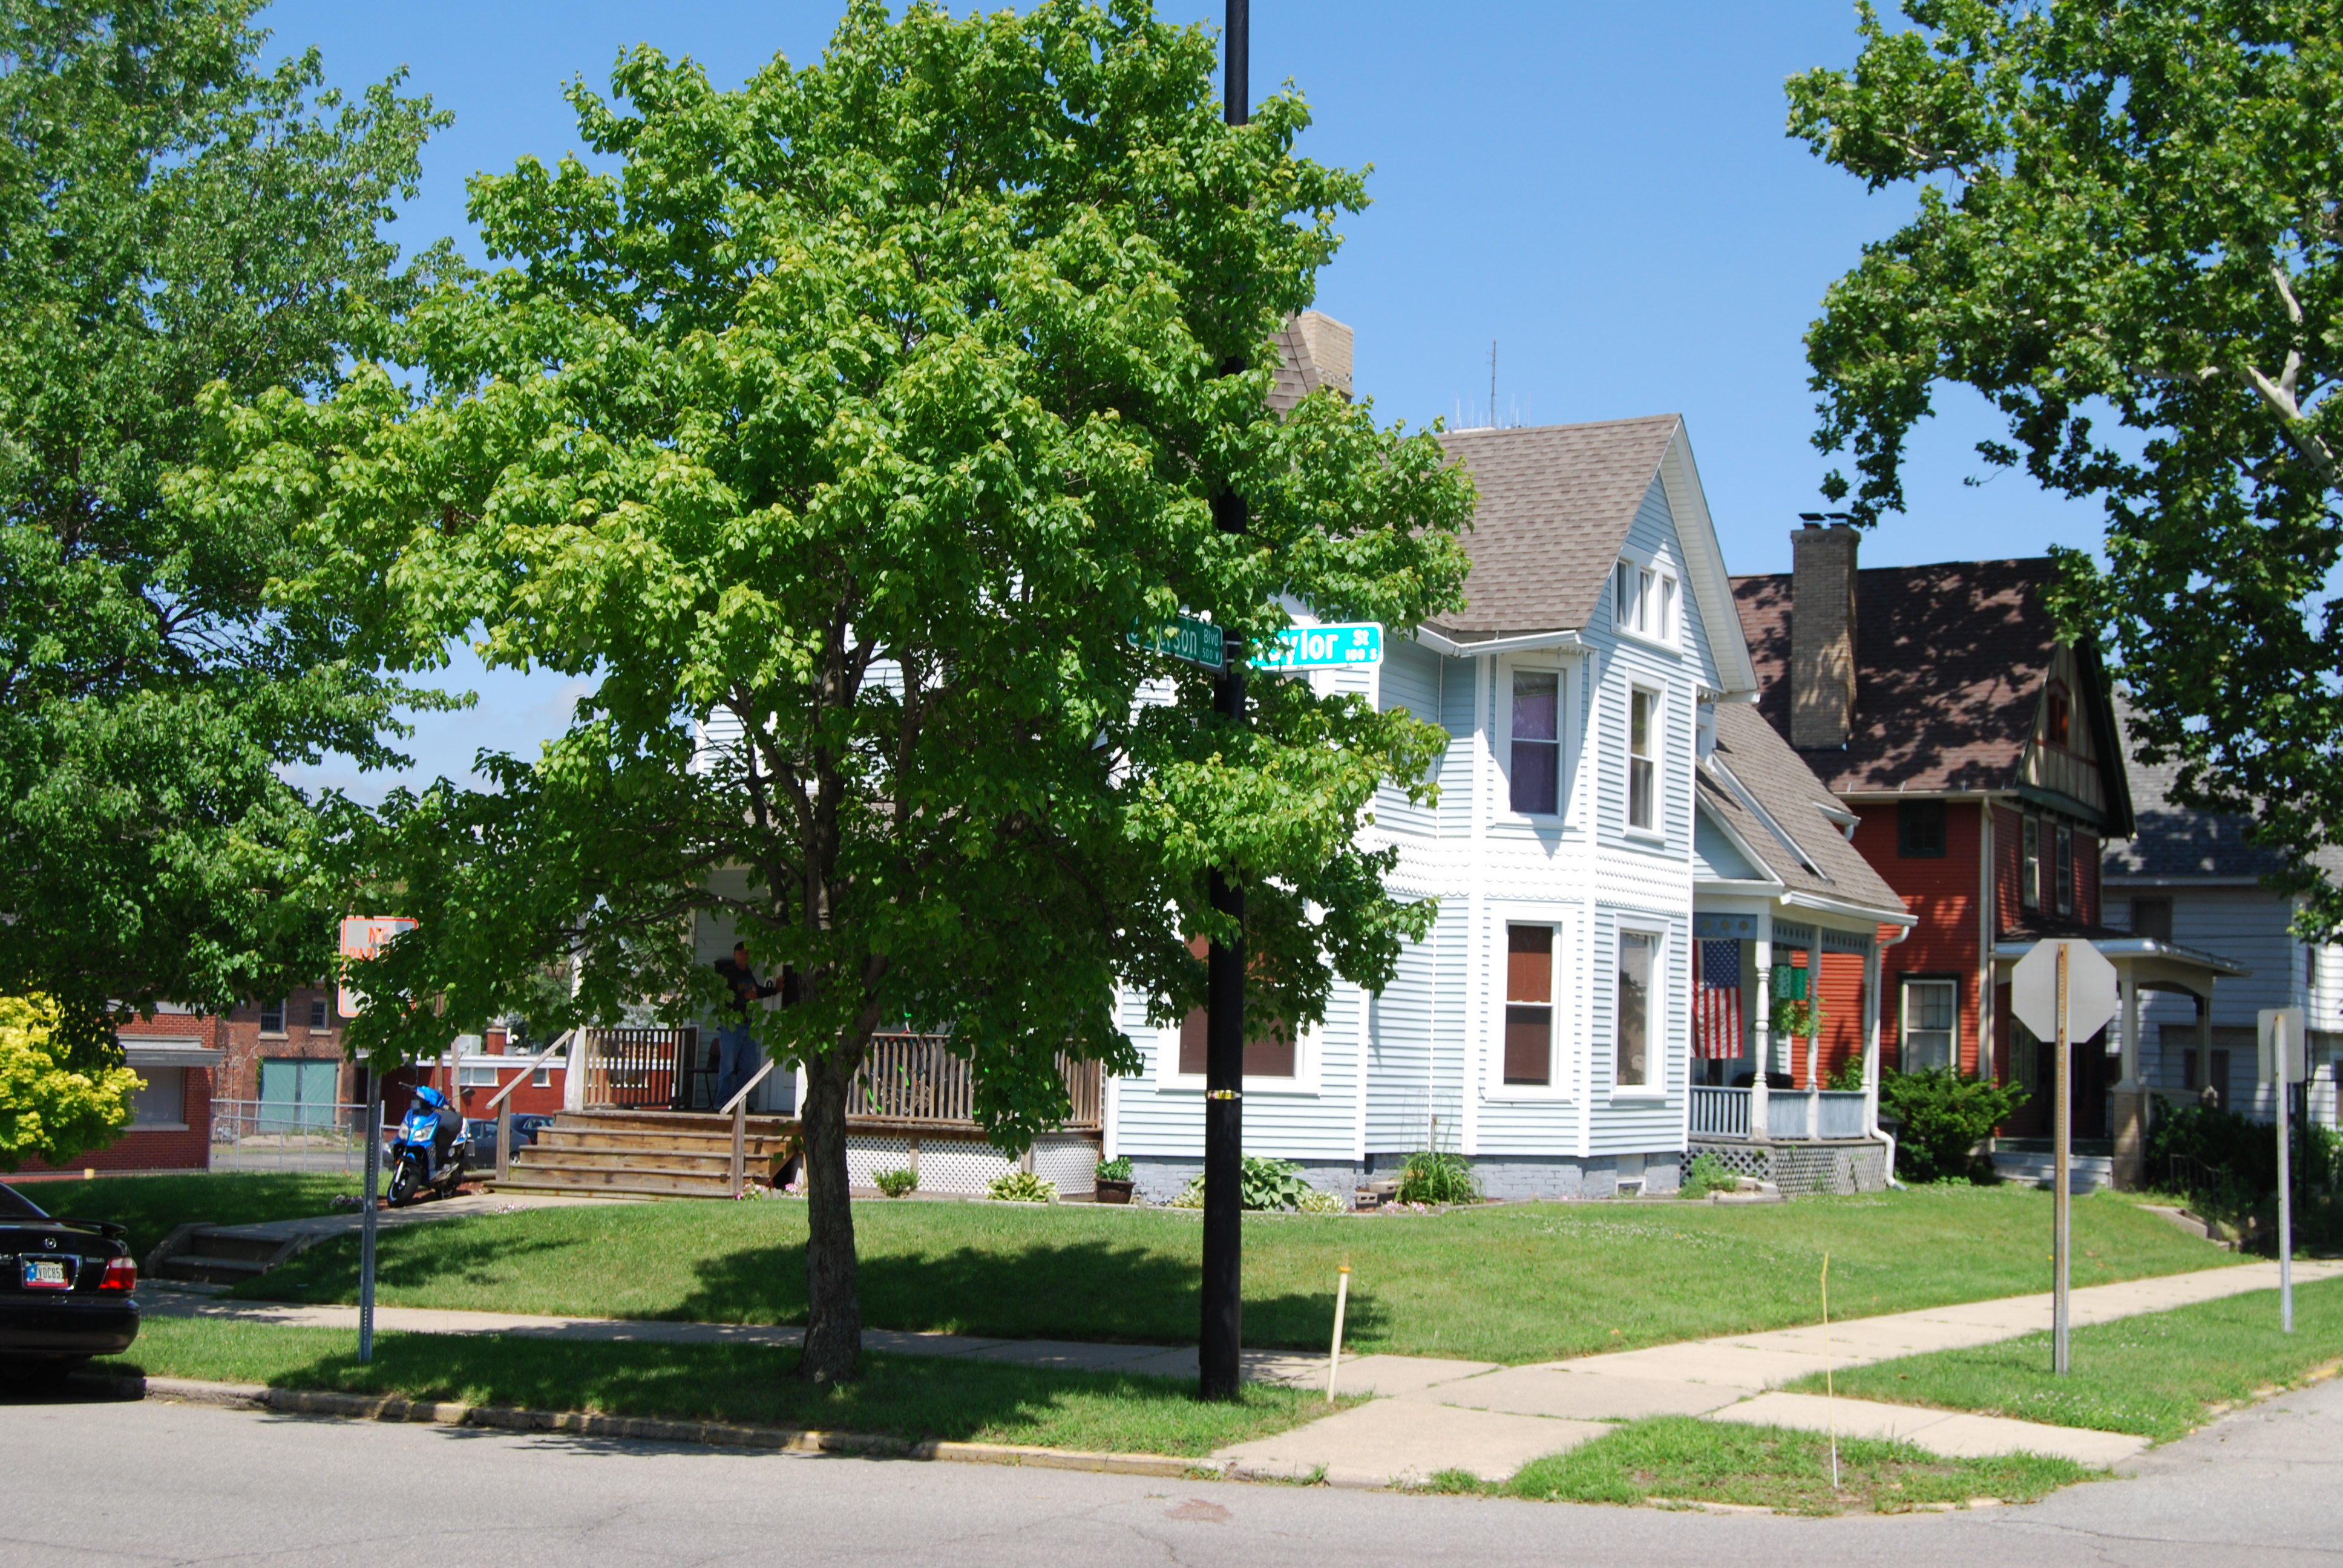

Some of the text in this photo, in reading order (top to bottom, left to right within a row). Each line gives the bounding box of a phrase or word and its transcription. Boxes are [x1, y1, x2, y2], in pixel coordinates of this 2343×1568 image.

[1204, 628, 1218, 646] Blvd
[1352, 629, 1369, 646] St
[1202, 647, 1219, 661] 500 W
[1369, 647, 1377, 661] S
[369, 926, 392, 944] NO
